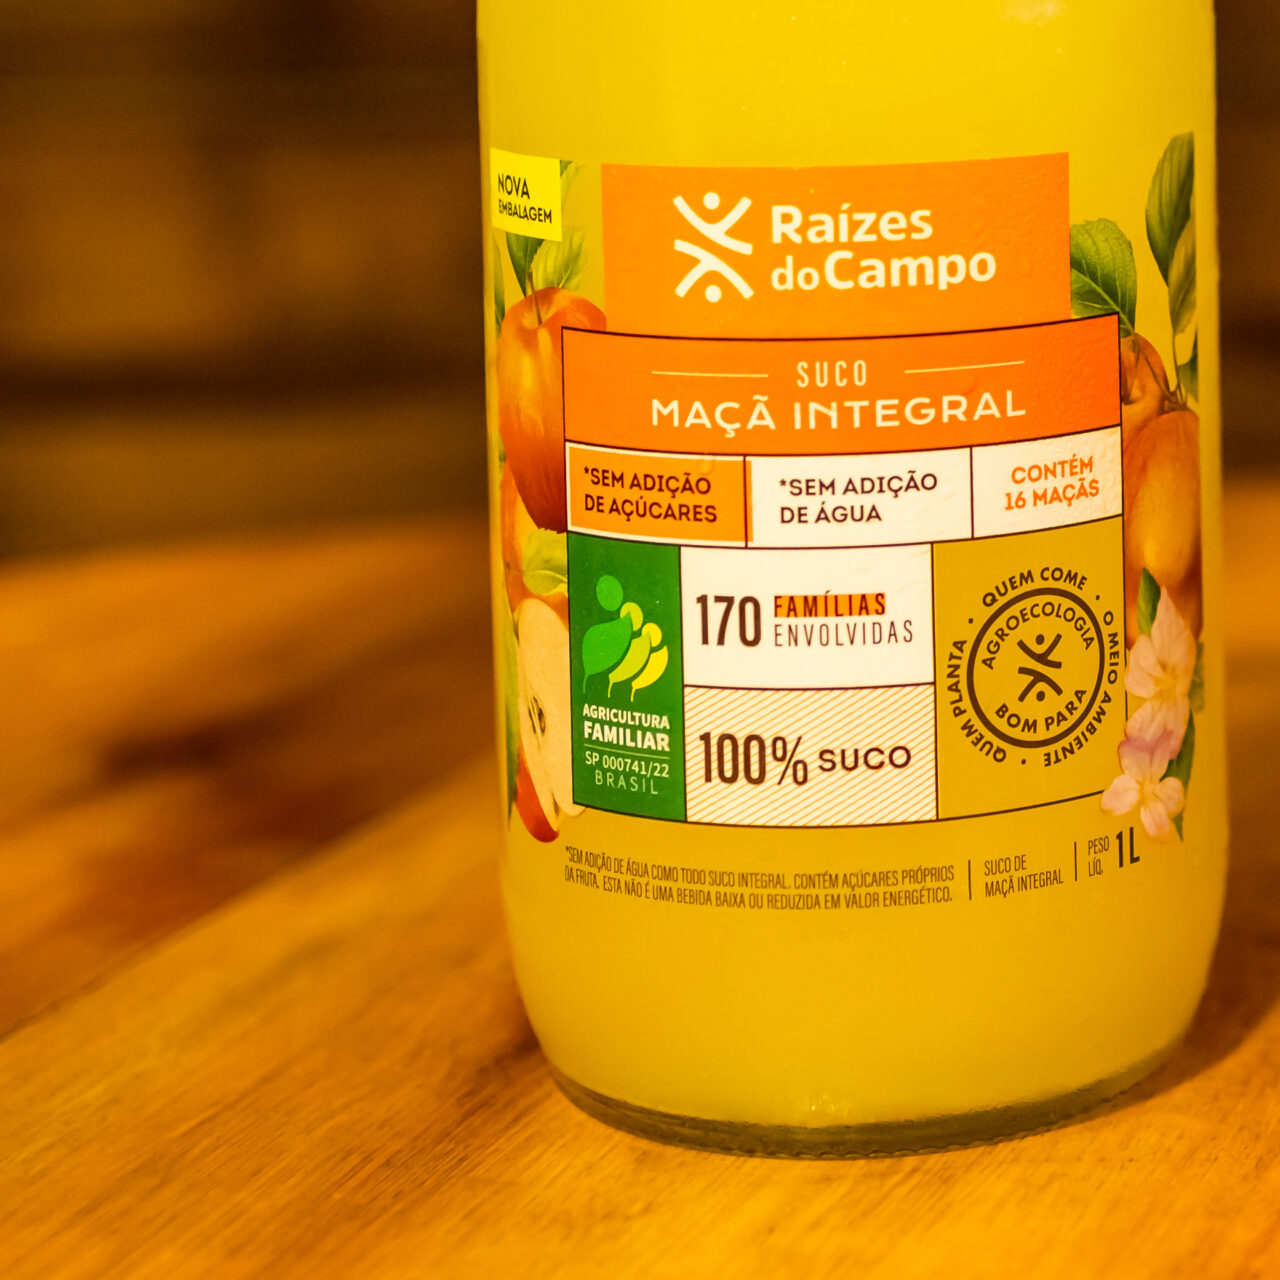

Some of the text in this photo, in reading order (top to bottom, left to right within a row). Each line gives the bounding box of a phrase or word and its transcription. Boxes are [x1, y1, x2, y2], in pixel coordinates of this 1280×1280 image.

[498, 172, 530, 199] NOVA
[499, 199, 552, 224] EMBALAGEM
[771, 203, 933, 243] Raízes
[797, 360, 867, 387] SUCO
[651, 390, 1026, 438] MAÇÃ INTEGRAL
[1011, 454, 1094, 484] CONTÉM
[629, 472, 711, 499] ADIÇÃO
[843, 471, 938, 499] ADIÇÃO
[1004, 477, 1099, 511] 16 MAÇÃS
[584, 494, 717, 522] DE AÇÚCARES
[780, 501, 882, 524] DE ÁGUA
[982, 566, 1088, 608] QUEM COME
[774, 590, 885, 618] FAMÍLIAS
[696, 594, 762, 648] 170
[774, 620, 913, 647] ENVOLVIDAS
[981, 601, 1095, 670] AGROECOLOGIA
[946, 639, 1007, 763] QUEM PLANTA
[1044, 611, 1120, 768] O MEIO AMBIENTE
[583, 703, 670, 730] AGRICULTURA
[995, 689, 1087, 734] BOM PARA
[584, 720, 670, 751] FAMILIAR
[585, 751, 669, 778] SP 000741/22
[699, 731, 912, 786] 100% SUCO
[595, 769, 658, 795] BRASIL
[1088, 835, 1109, 856] PESO
[584, 851, 612, 873] ADIÇÃO
[614, 857, 624, 875] DE
[626, 857, 649, 879] ÁGUA
[651, 864, 678, 883] COMO
[680, 867, 706, 885] TODO
[708, 870, 735, 888] SUCO
[738, 872, 791, 890] INTEGRAL.
[793, 870, 839, 890] CONTÉM
[842, 869, 899, 892] AÇÚCARES
[901, 865, 954, 885] PRÓPRIOS
[984, 854, 1027, 876] SUCO DE
[565, 864, 952, 910] DA FRUTA. ESTA NÃO É UMA BEBIDA BAIXA OU REDUZIDA EM VALOR ENERGÉTICO.
[985, 868, 1064, 898] MAÇÃ INTEGRAL
